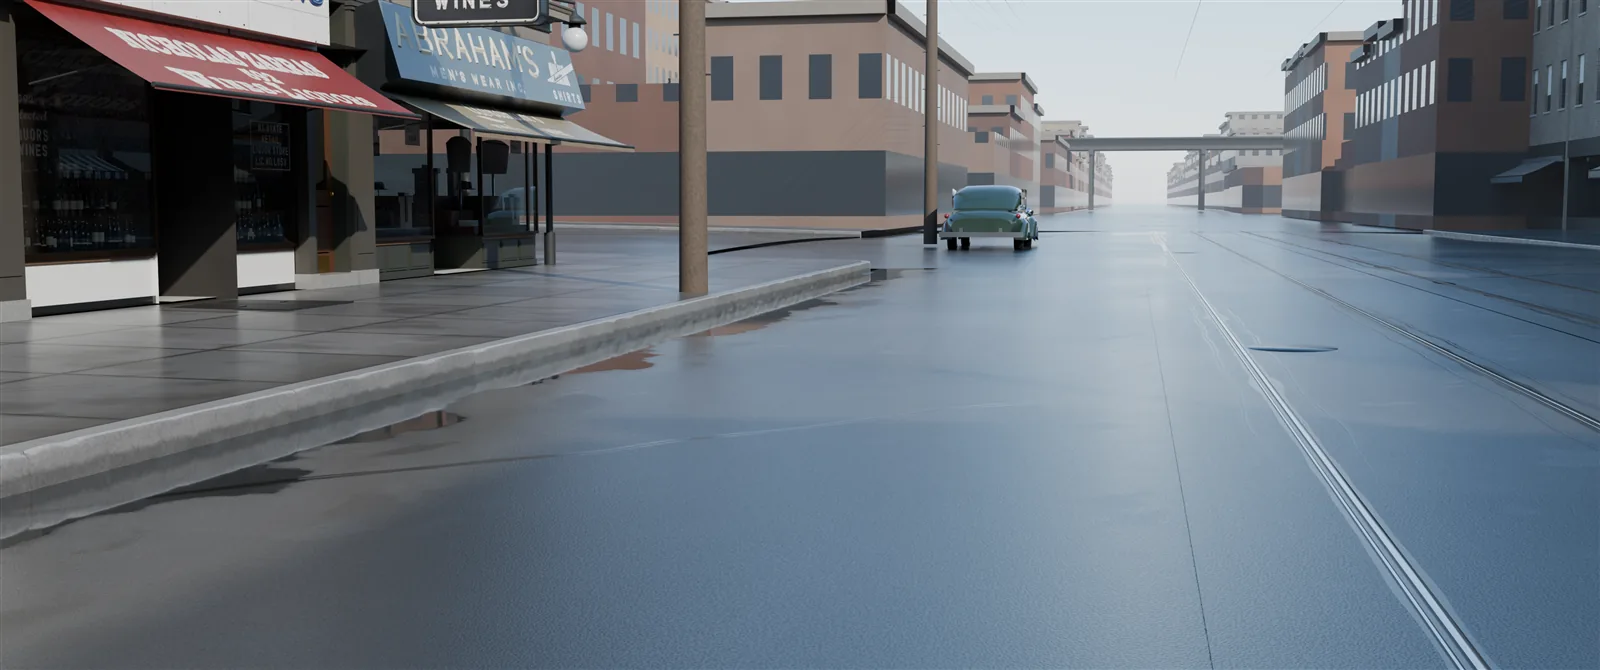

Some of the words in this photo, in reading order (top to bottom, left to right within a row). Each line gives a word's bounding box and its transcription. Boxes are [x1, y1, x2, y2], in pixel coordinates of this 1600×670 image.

[435, 0, 509, 10] WINES
[104, 26, 239, 67] NICHOLAS
[235, 51, 330, 79] ZARRAS
[394, 12, 540, 78] ABRAHAM'S
[430, 65, 467, 84] MEN'S
[471, 73, 502, 90] WEAR
[552, 89, 582, 105] SHIRTS
